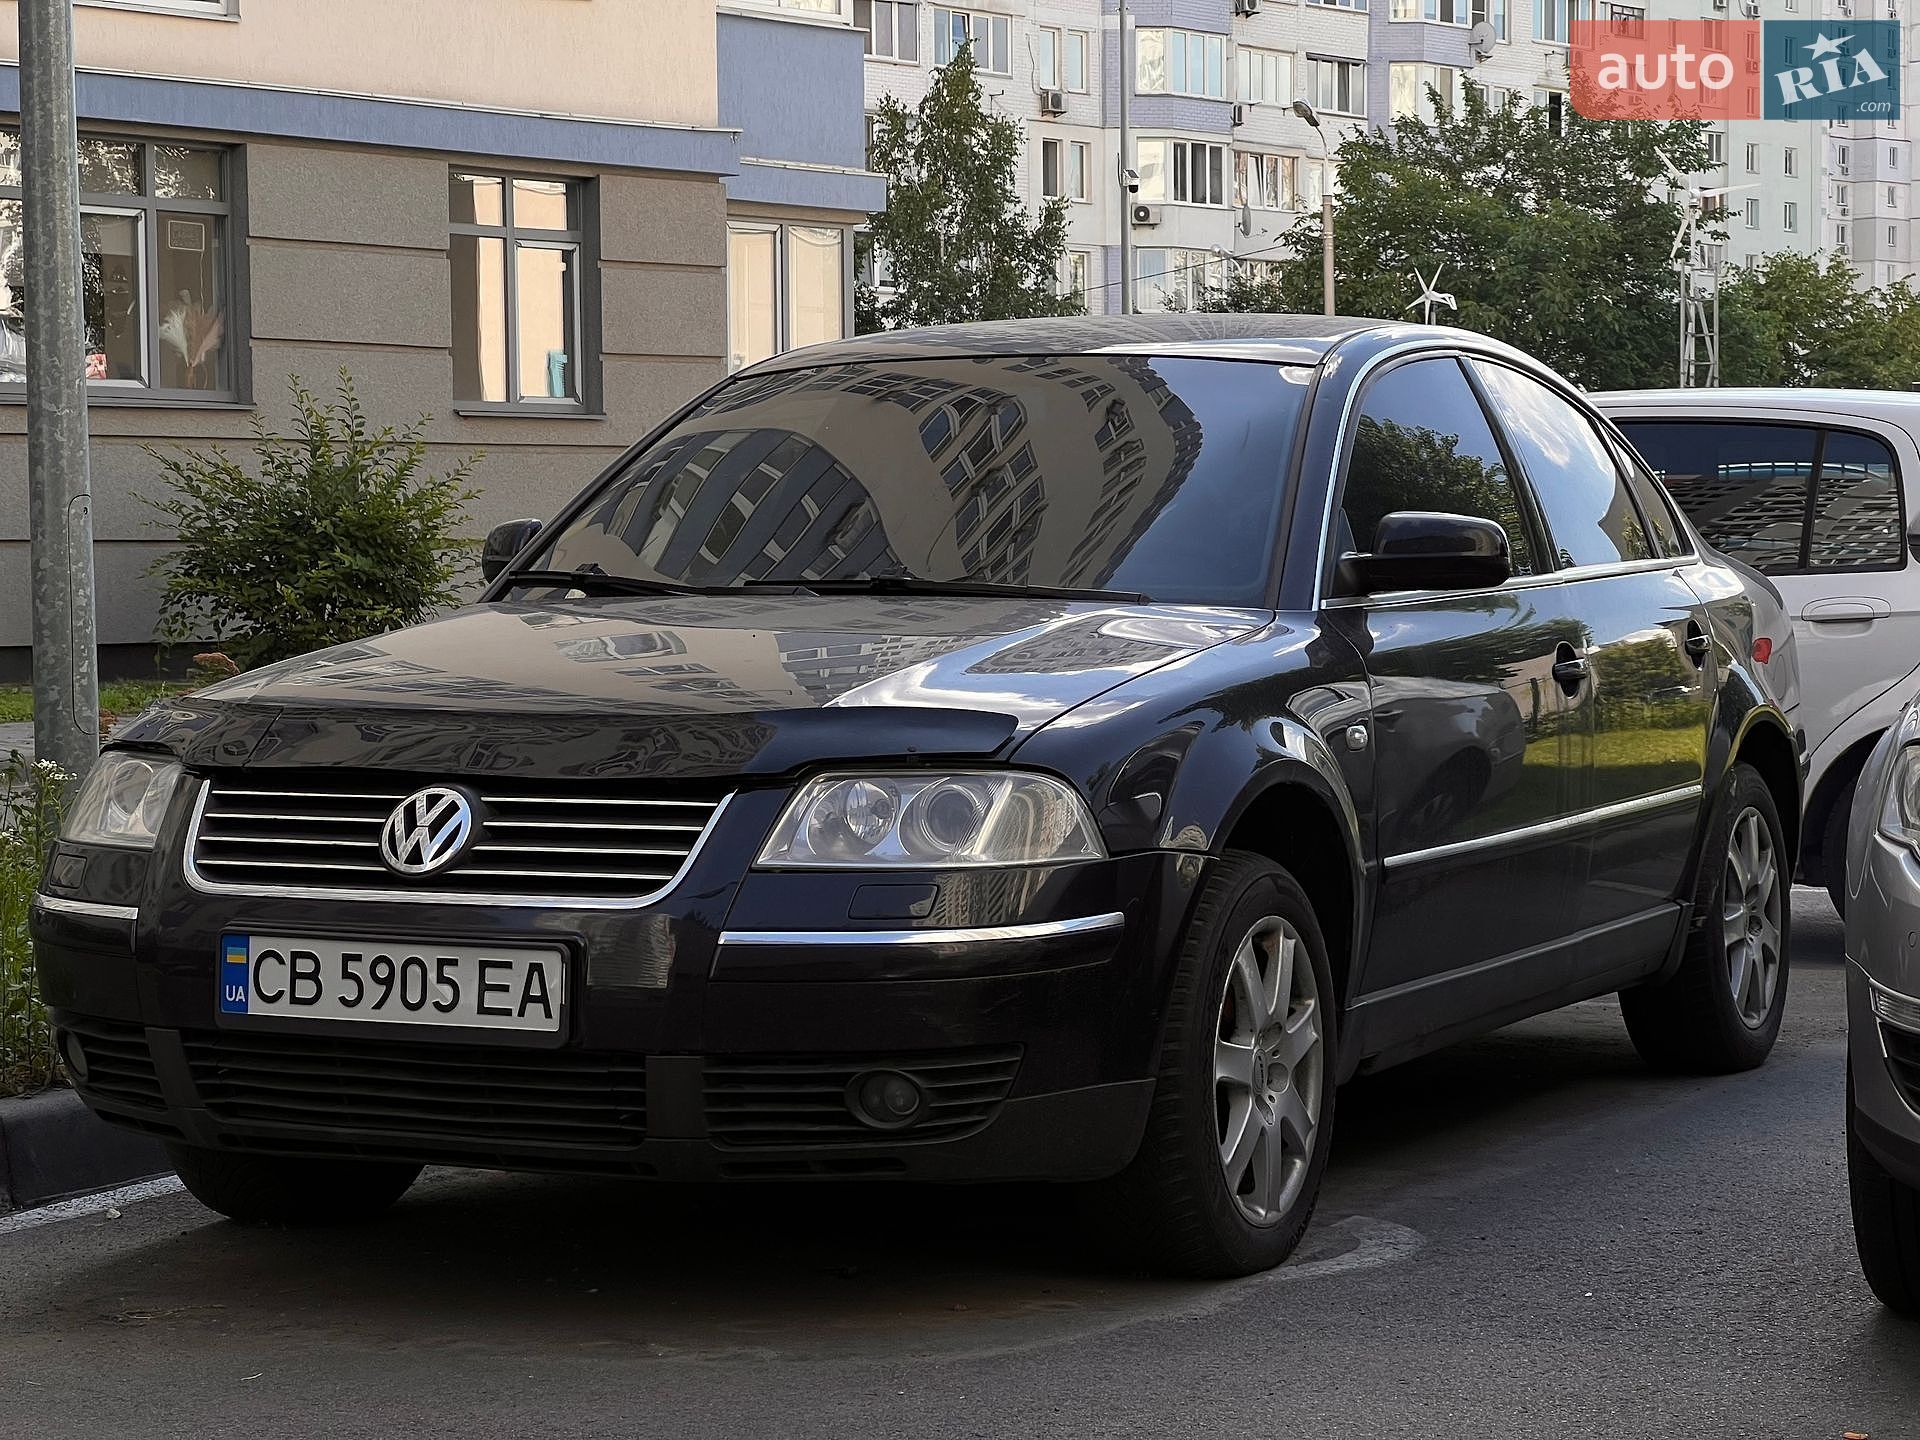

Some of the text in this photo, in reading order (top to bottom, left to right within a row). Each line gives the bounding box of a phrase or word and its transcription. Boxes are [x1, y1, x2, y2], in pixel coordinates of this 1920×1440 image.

[225, 983, 246, 1003] UA
[252, 948, 553, 1020] CB 5905 EA
